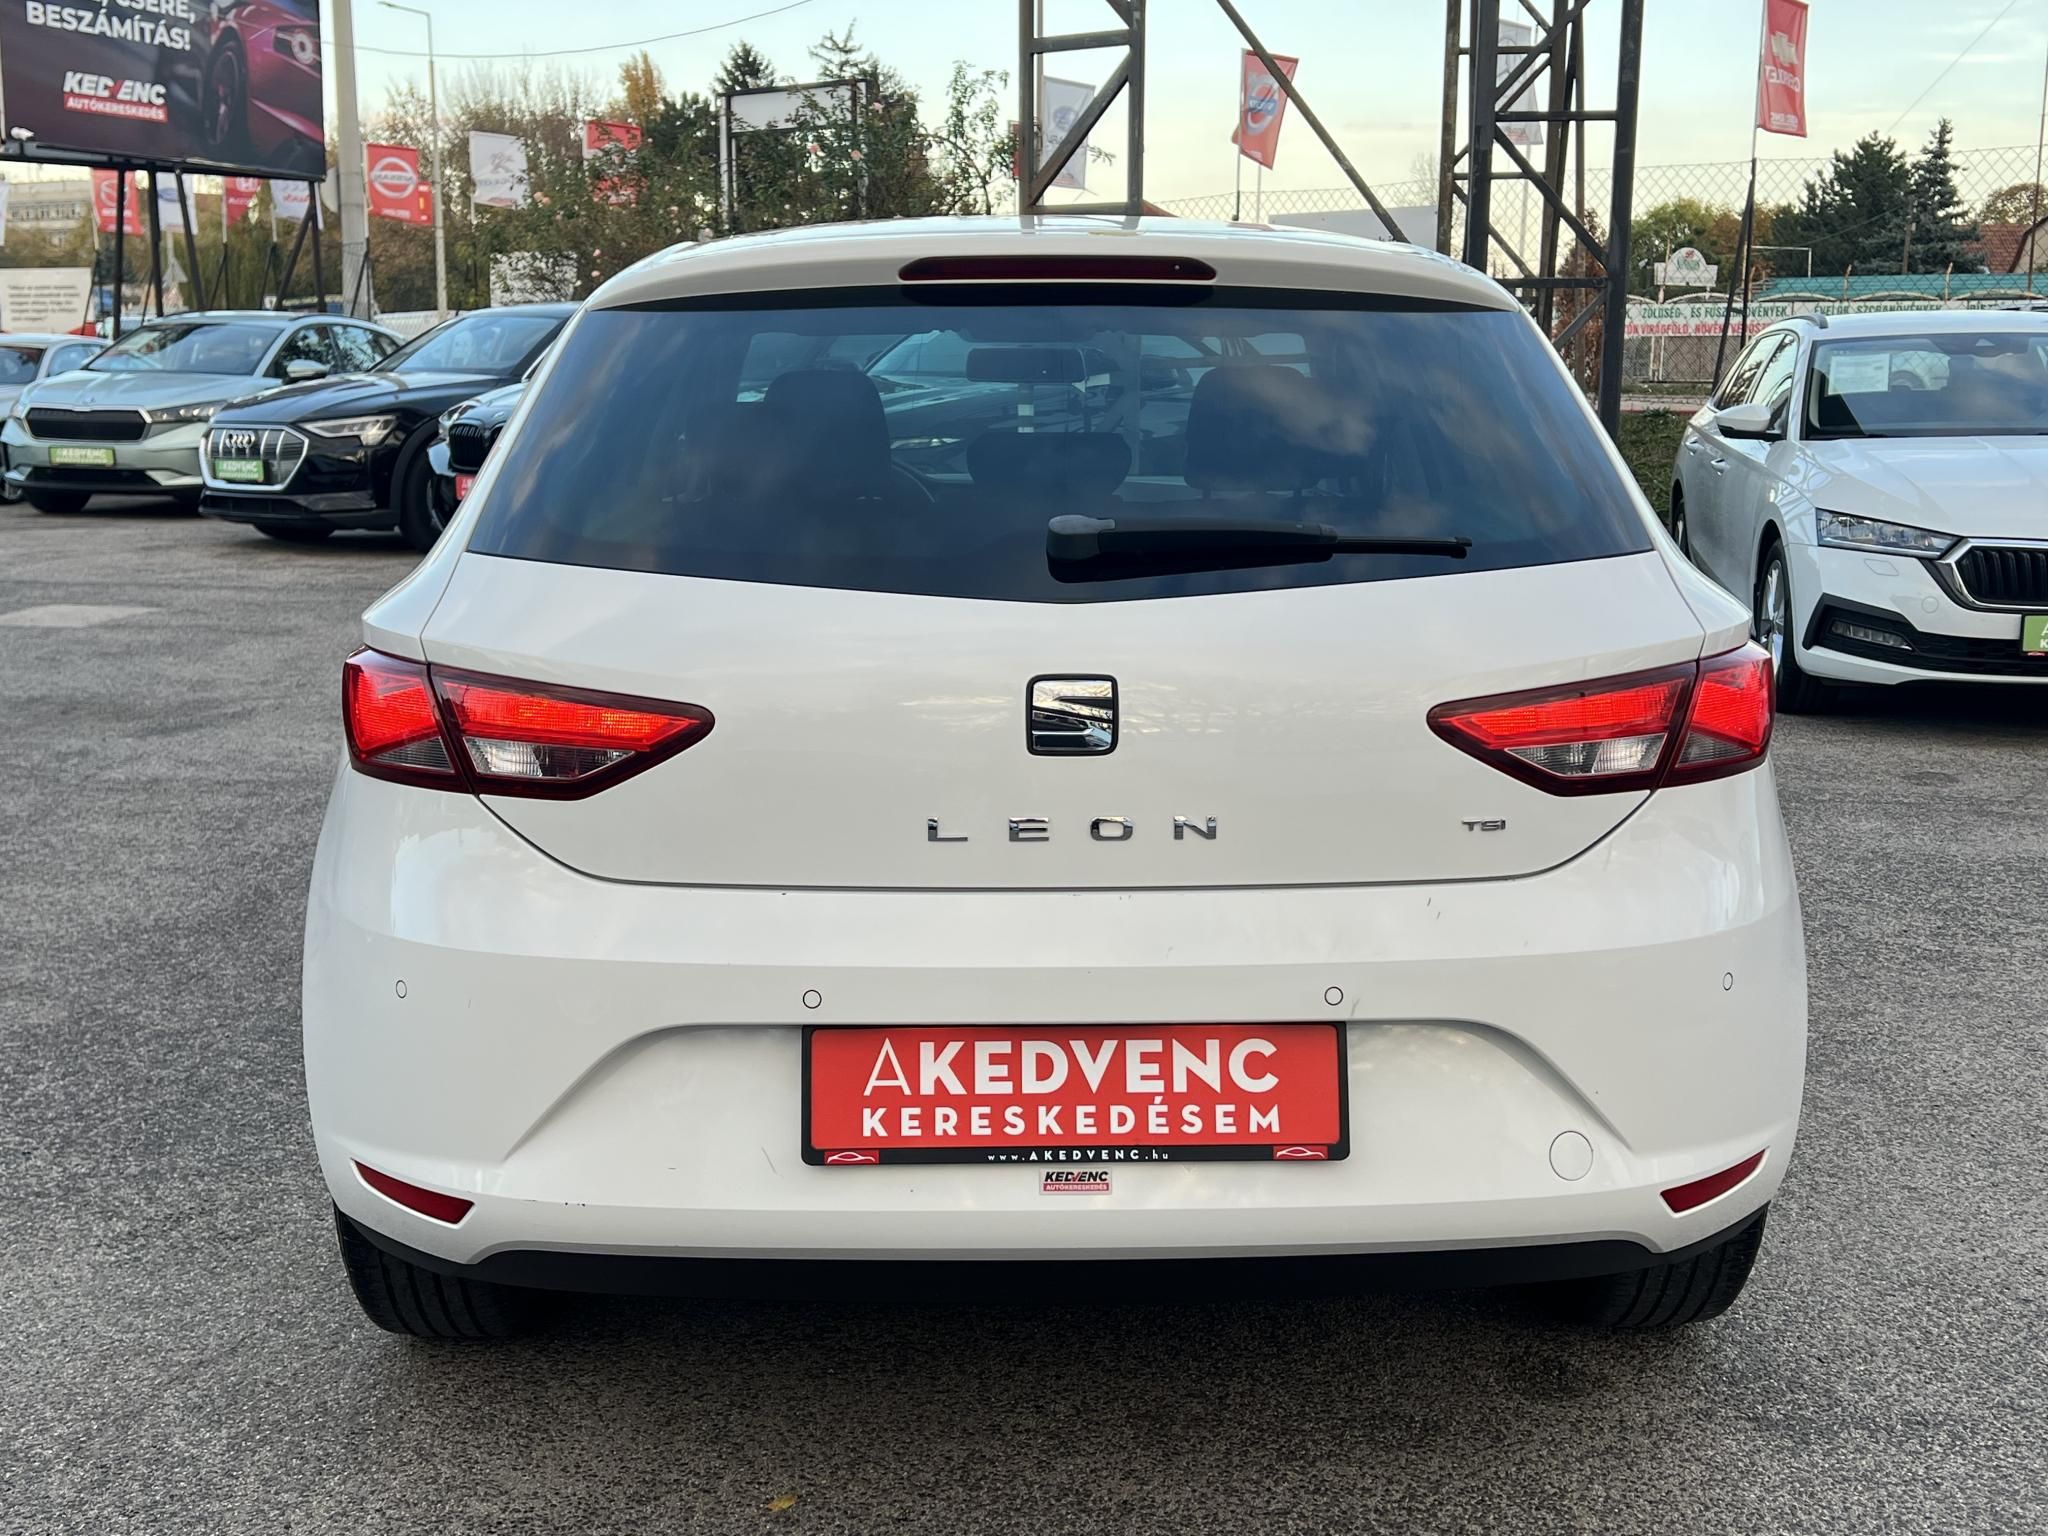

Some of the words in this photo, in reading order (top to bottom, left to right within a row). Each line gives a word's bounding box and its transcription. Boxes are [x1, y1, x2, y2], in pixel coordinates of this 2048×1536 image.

[26, 0, 191, 51] BESZÁMÍTÁS!
[927, 815, 1218, 843] LEON
[862, 1095, 1281, 1138] KERESKEDÉSEM
